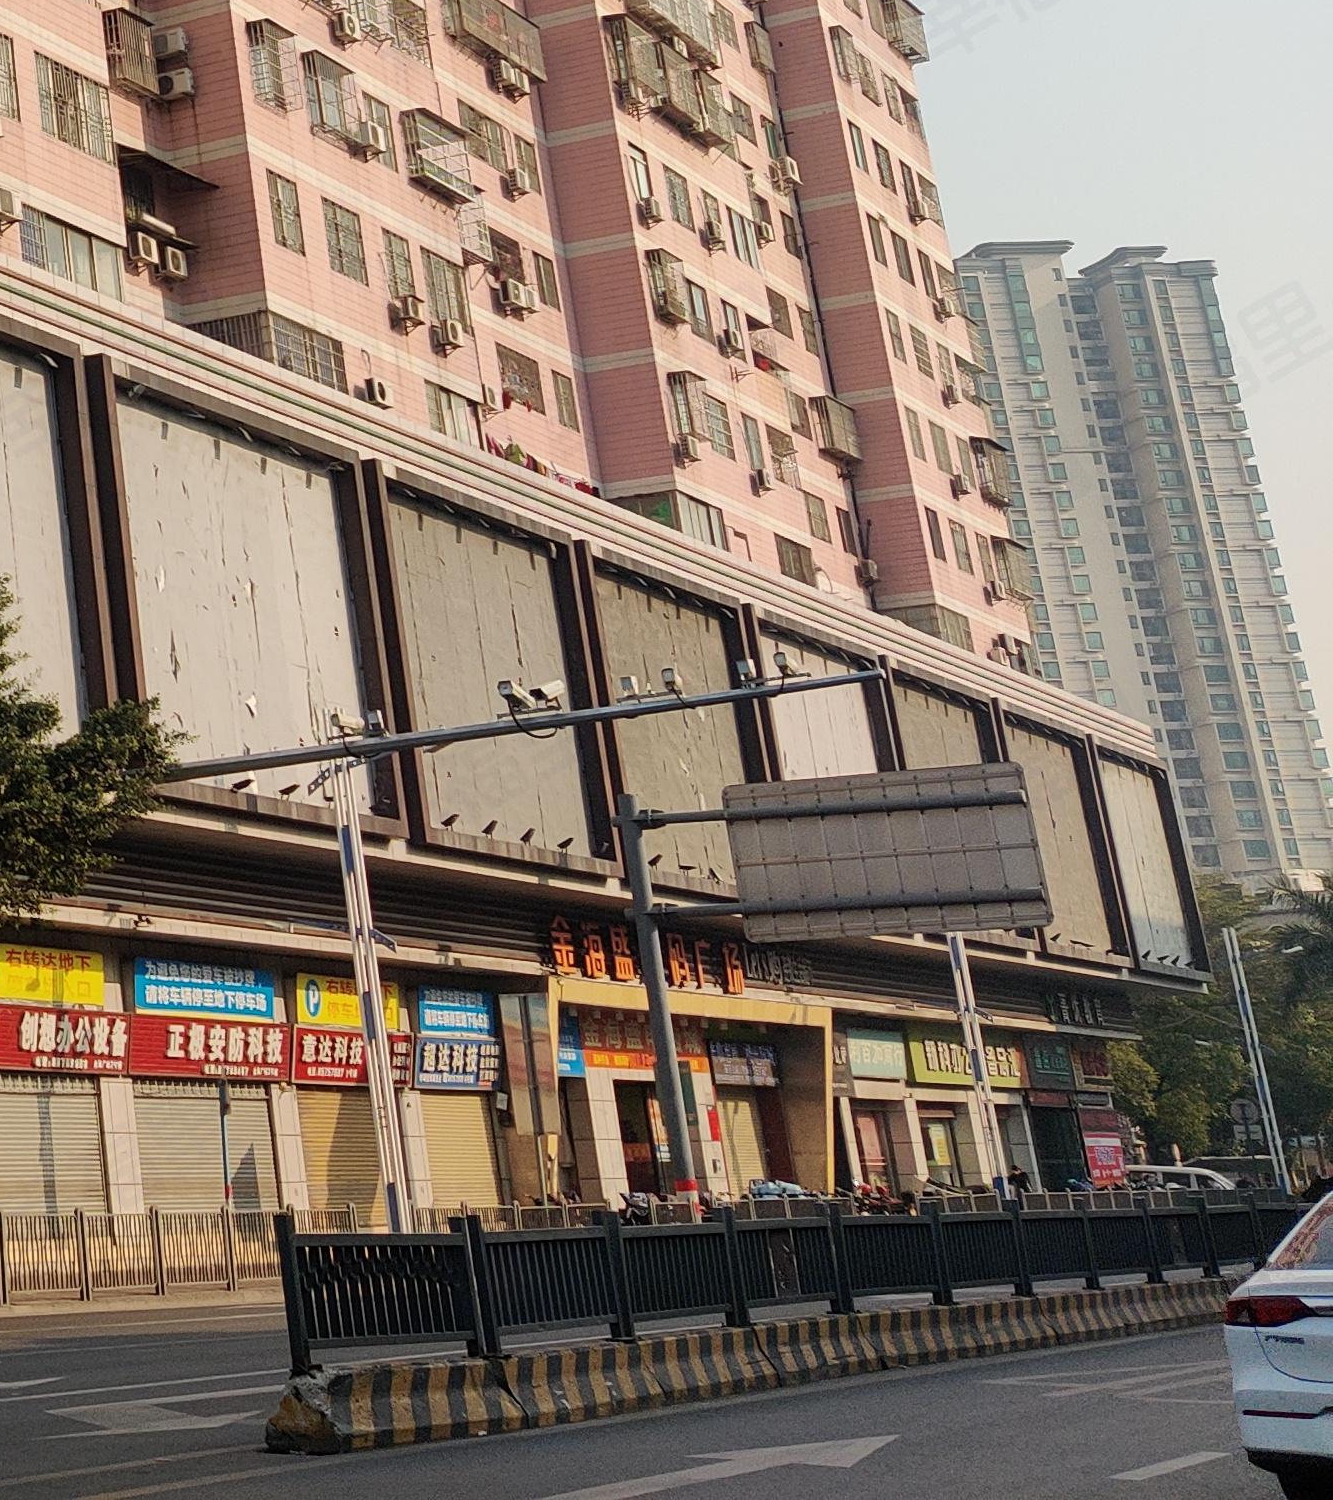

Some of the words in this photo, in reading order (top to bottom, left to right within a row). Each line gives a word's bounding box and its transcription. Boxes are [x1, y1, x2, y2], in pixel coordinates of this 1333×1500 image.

[5, 949, 91, 972] 右转达地下
[550, 915, 745, 995] 金海盛码广场
[325, 979, 394, 998] 右转下
[19, 1010, 128, 1057] 创想办公设备
[166, 1023, 283, 1064] 正极安防科技
[301, 1033, 364, 1066] 意达科技
